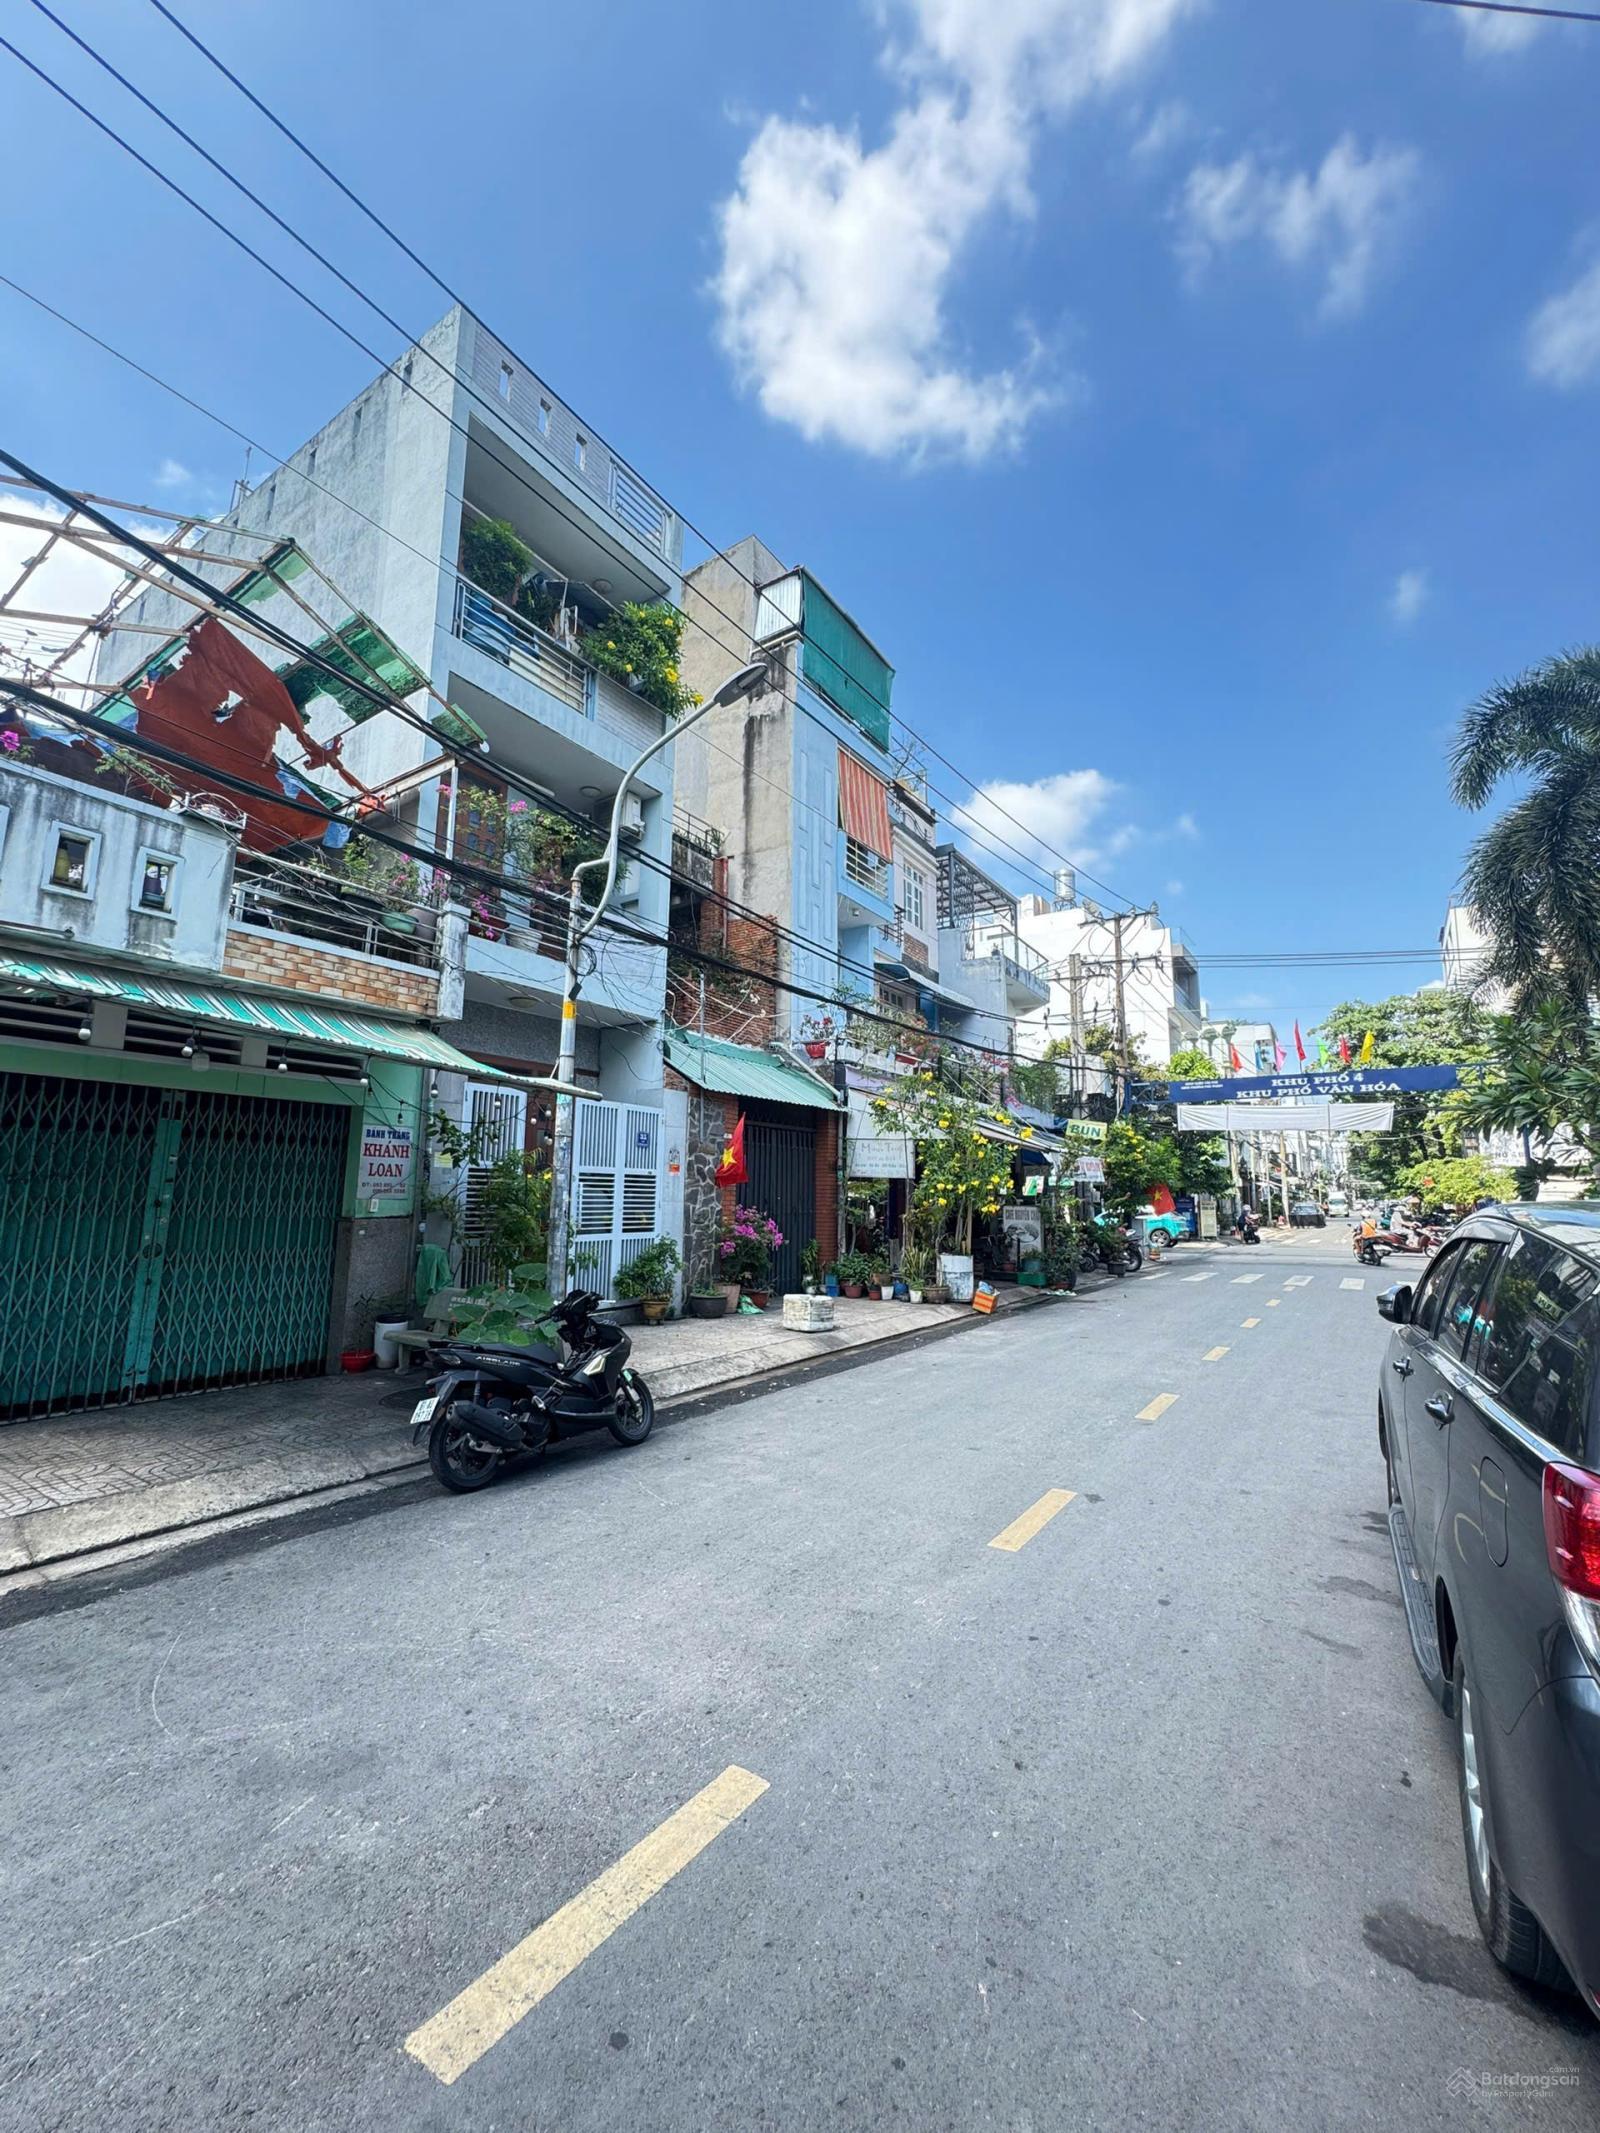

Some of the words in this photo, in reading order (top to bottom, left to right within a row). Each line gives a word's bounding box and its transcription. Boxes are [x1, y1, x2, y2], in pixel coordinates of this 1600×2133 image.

[1272, 1078, 1308, 1087] KHU
[1313, 1071, 1349, 1085] PHỐ
[1354, 1073, 1364, 1082] 4
[1236, 1089, 1272, 1099] KHU
[1277, 1083, 1312, 1096] PHỐ
[1317, 1083, 1354, 1094] VĂN
[1360, 1081, 1401, 1092] HÓA
[363, 1140, 410, 1159] KHÁNH
[367, 1162, 404, 1178] LOAN
